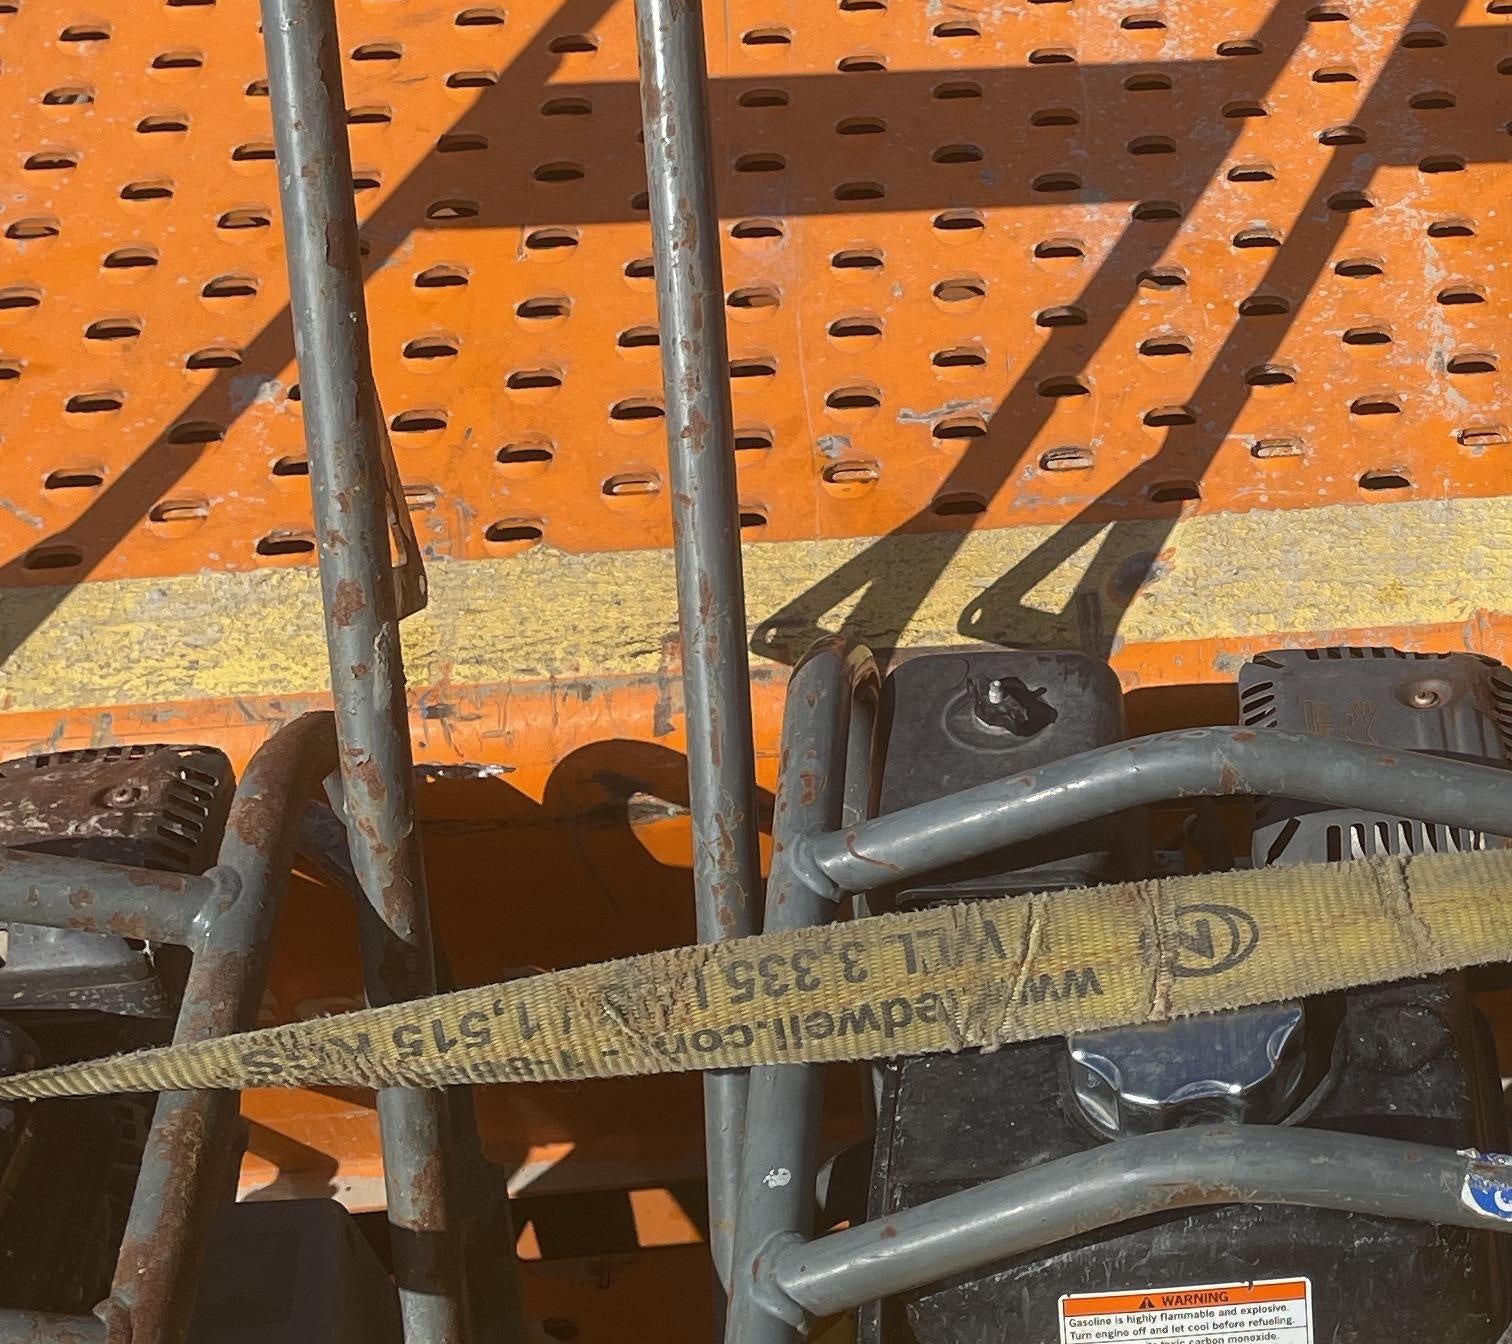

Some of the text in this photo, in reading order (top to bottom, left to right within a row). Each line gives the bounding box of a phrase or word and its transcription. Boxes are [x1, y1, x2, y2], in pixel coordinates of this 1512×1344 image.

[390, 998, 544, 1062] 1,515
[1161, 1291, 1229, 1307] WARNING
[1068, 1316, 1112, 1329] Gasoline
[1115, 1316, 1124, 1325] is
[1126, 1313, 1157, 1326] highly
[1160, 1308, 1215, 1322] flammable
[1218, 1307, 1237, 1317] and
[1069, 1330, 1093, 1341] Turn
[1095, 1327, 1130, 1342] engine
[1132, 1325, 1147, 1336] off
[1149, 1324, 1168, 1335] and
[1171, 1322, 1185, 1333] let
[1187, 1320, 1210, 1332] cool
[1212, 1318, 1245, 1330] before
